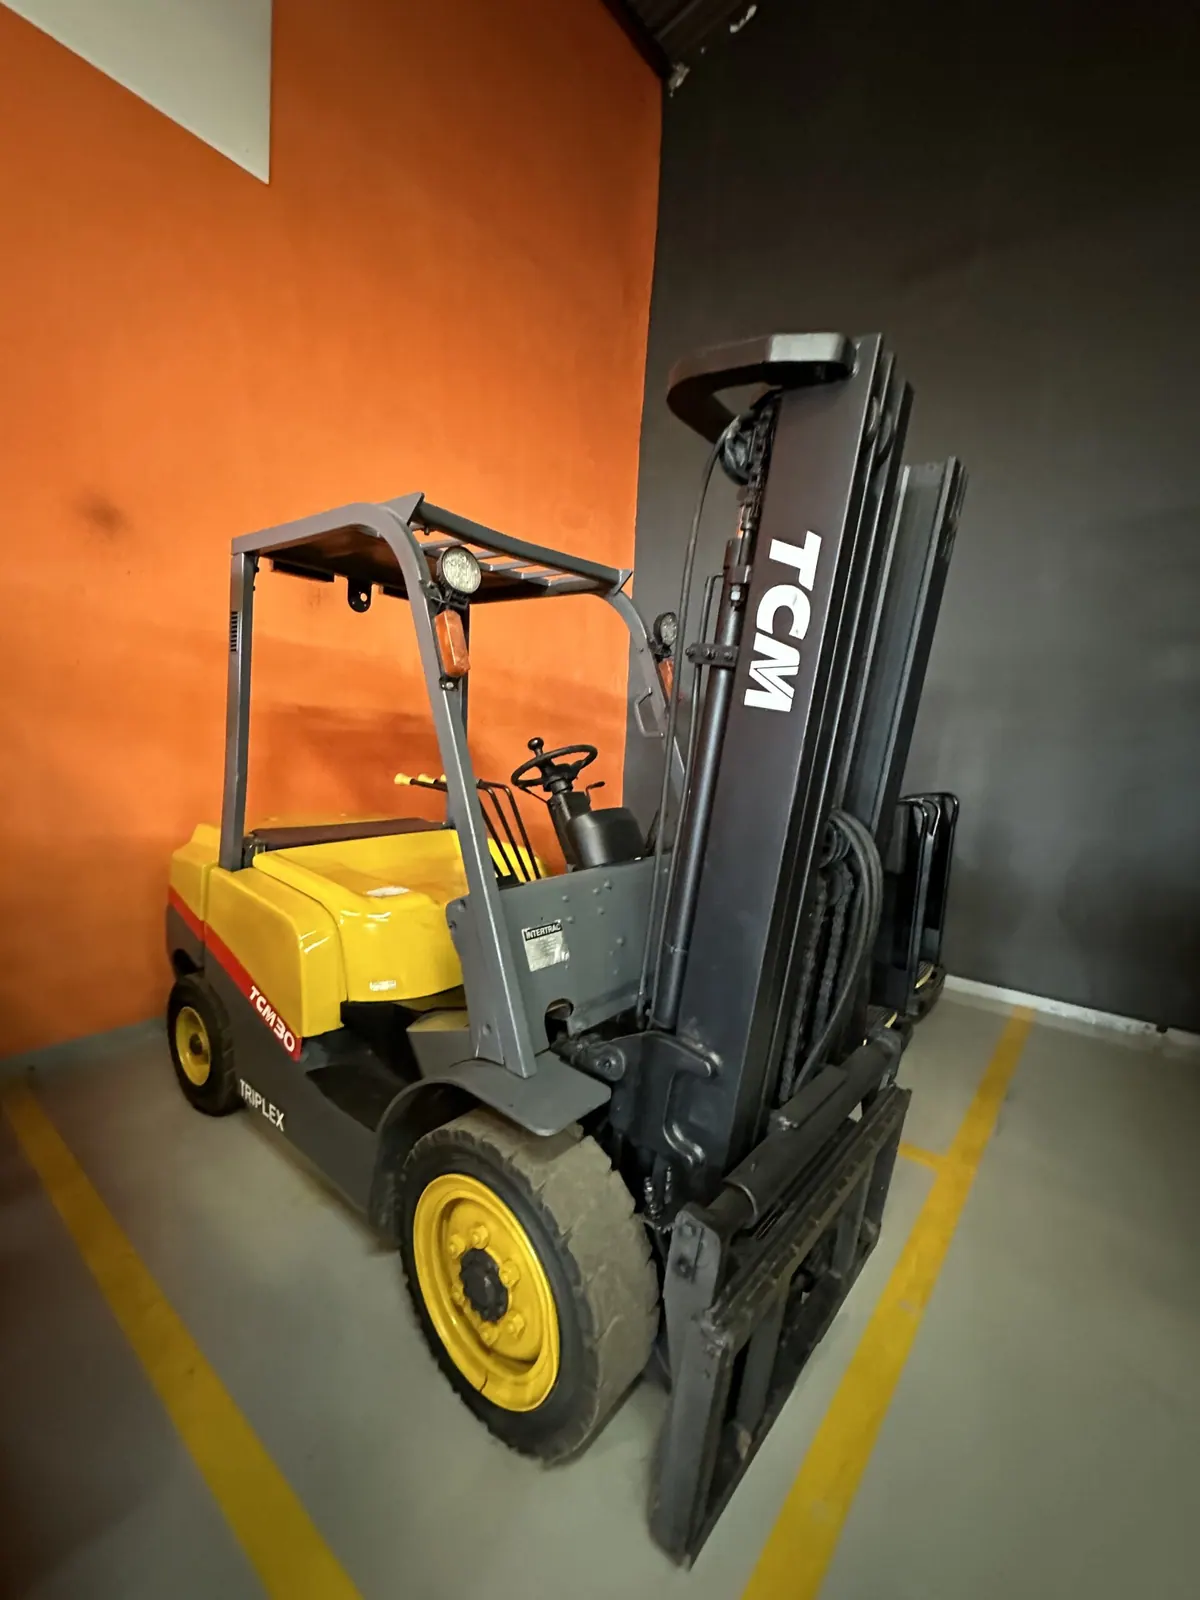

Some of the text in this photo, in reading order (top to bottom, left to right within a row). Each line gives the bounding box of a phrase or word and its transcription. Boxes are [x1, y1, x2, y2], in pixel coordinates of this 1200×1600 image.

[744, 530, 822, 712] TCM
[525, 923, 562, 939] INTERTRAC
[239, 1078, 285, 1132] TRIPLEX
